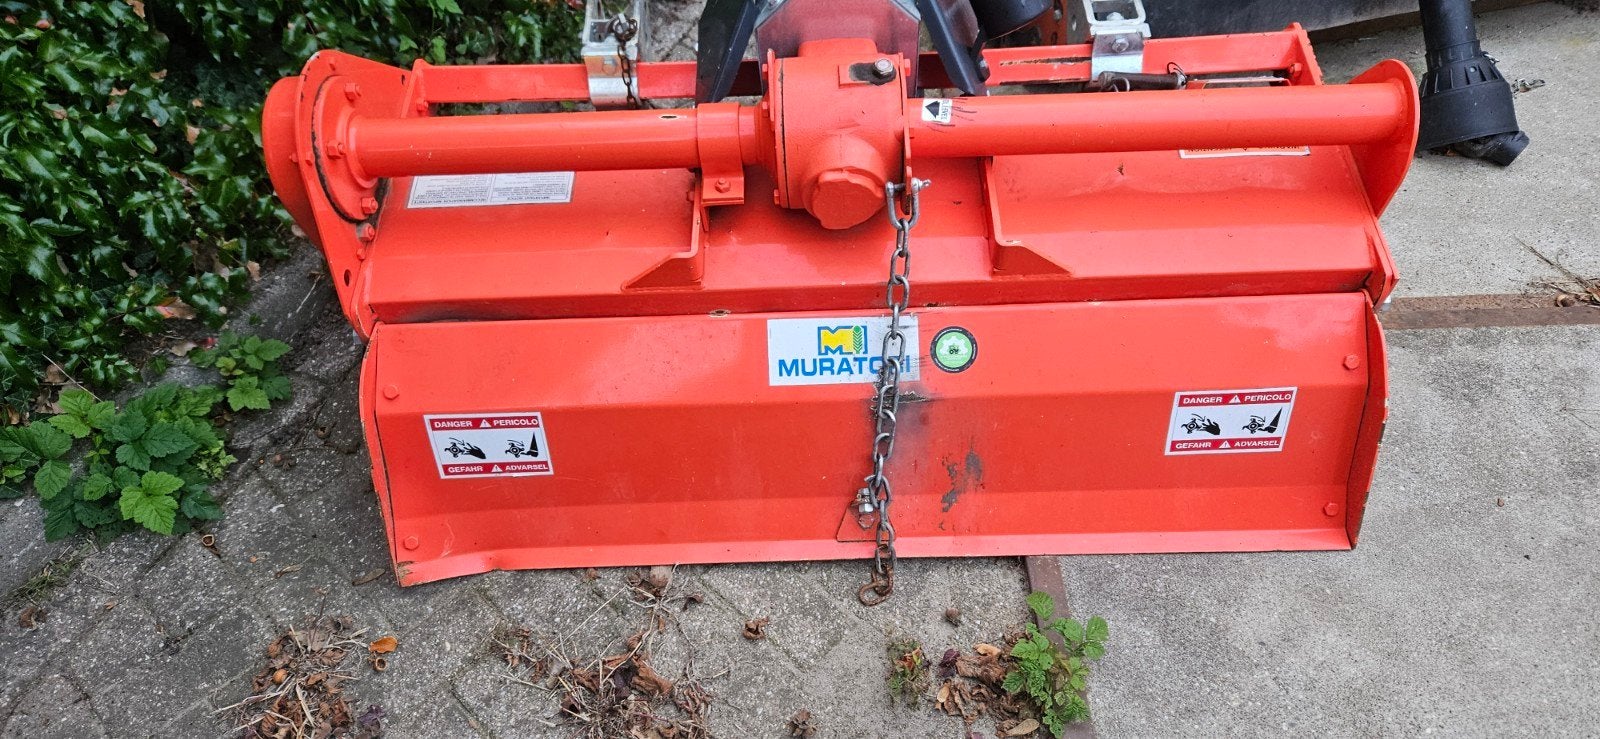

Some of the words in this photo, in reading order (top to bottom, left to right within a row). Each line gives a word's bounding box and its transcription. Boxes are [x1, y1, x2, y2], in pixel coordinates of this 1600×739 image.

[1183, 396, 1223, 404] DANGER
[1244, 393, 1292, 402] PERICOLO
[493, 418, 538, 426] PERICOLO
[448, 465, 483, 473] GEFAHR
